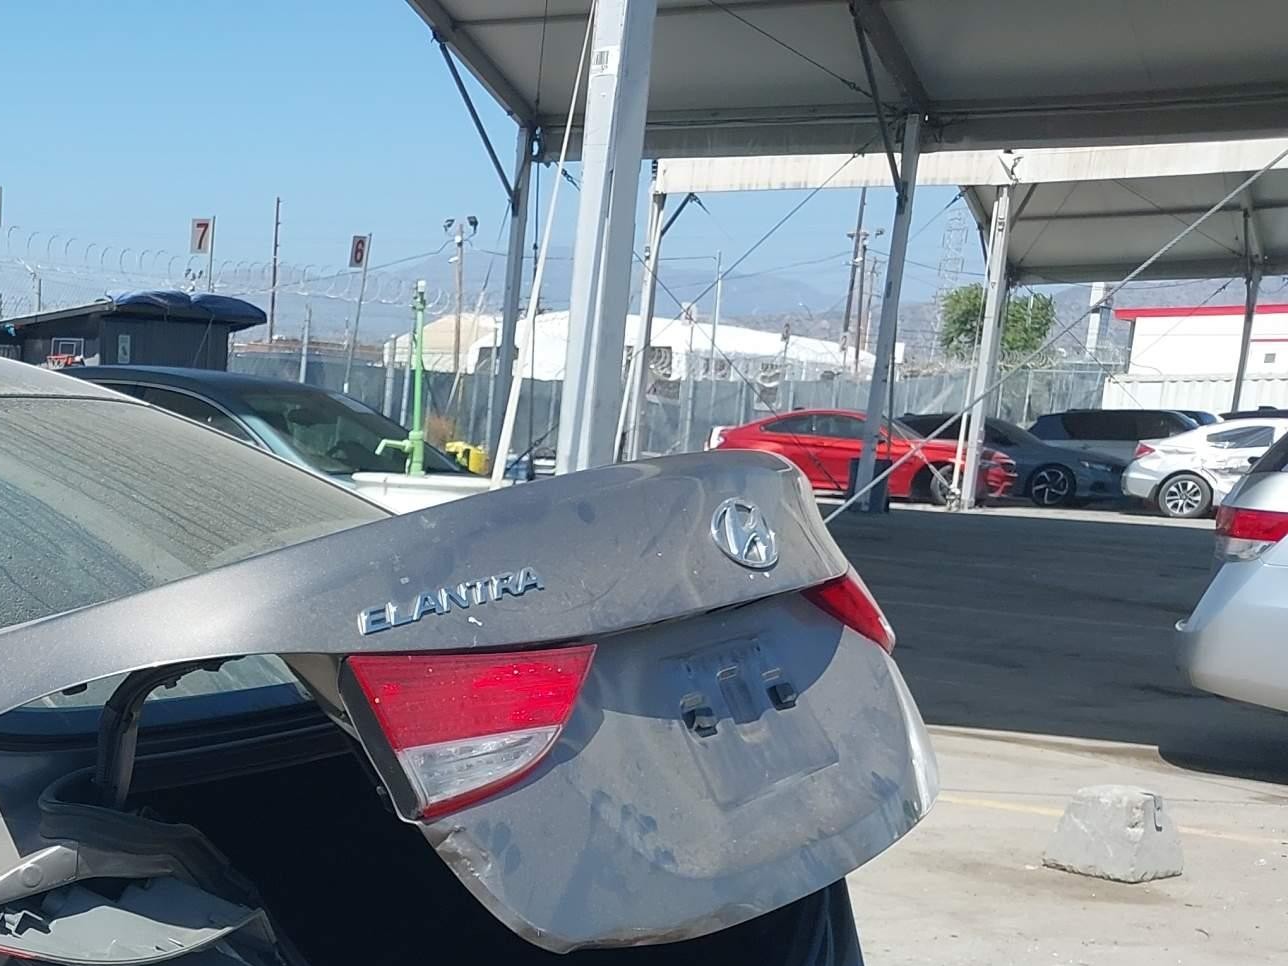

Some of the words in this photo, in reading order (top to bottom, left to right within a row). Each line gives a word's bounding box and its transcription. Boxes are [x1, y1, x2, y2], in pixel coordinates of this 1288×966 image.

[196, 222, 209, 250] 7
[354, 239, 365, 264] 6
[357, 566, 545, 636] ELANTRA
